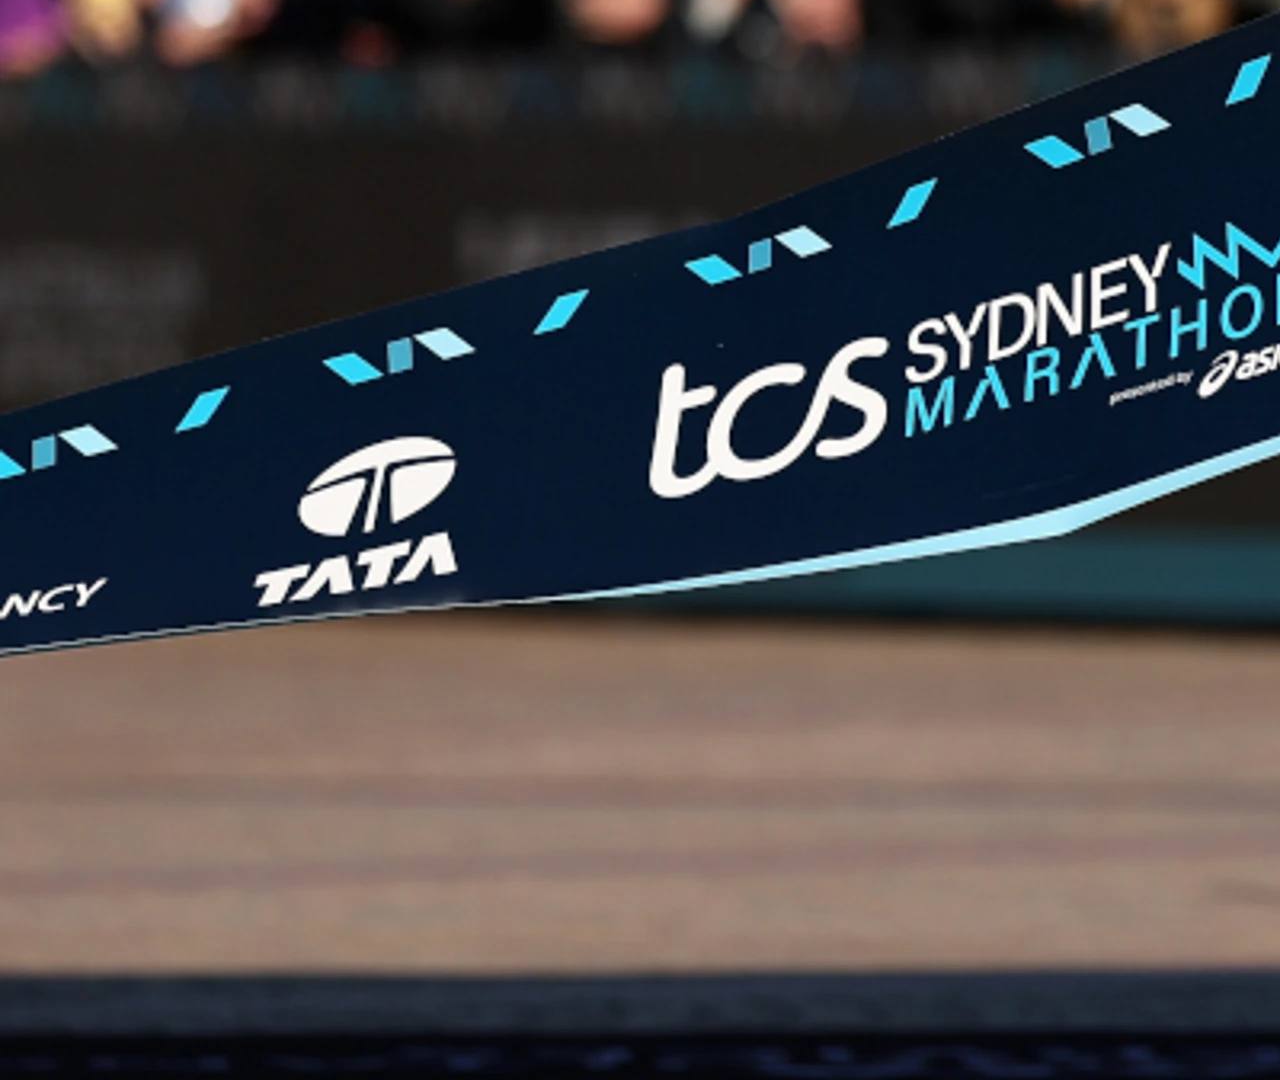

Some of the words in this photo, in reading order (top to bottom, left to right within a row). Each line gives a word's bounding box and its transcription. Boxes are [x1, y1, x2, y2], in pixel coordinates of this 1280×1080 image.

[903, 242, 1172, 385] SYDNEY
[648, 336, 890, 498] tcs
[1109, 372, 1176, 407] presented
[1176, 369, 1195, 387] by
[252, 531, 459, 607] TATA
